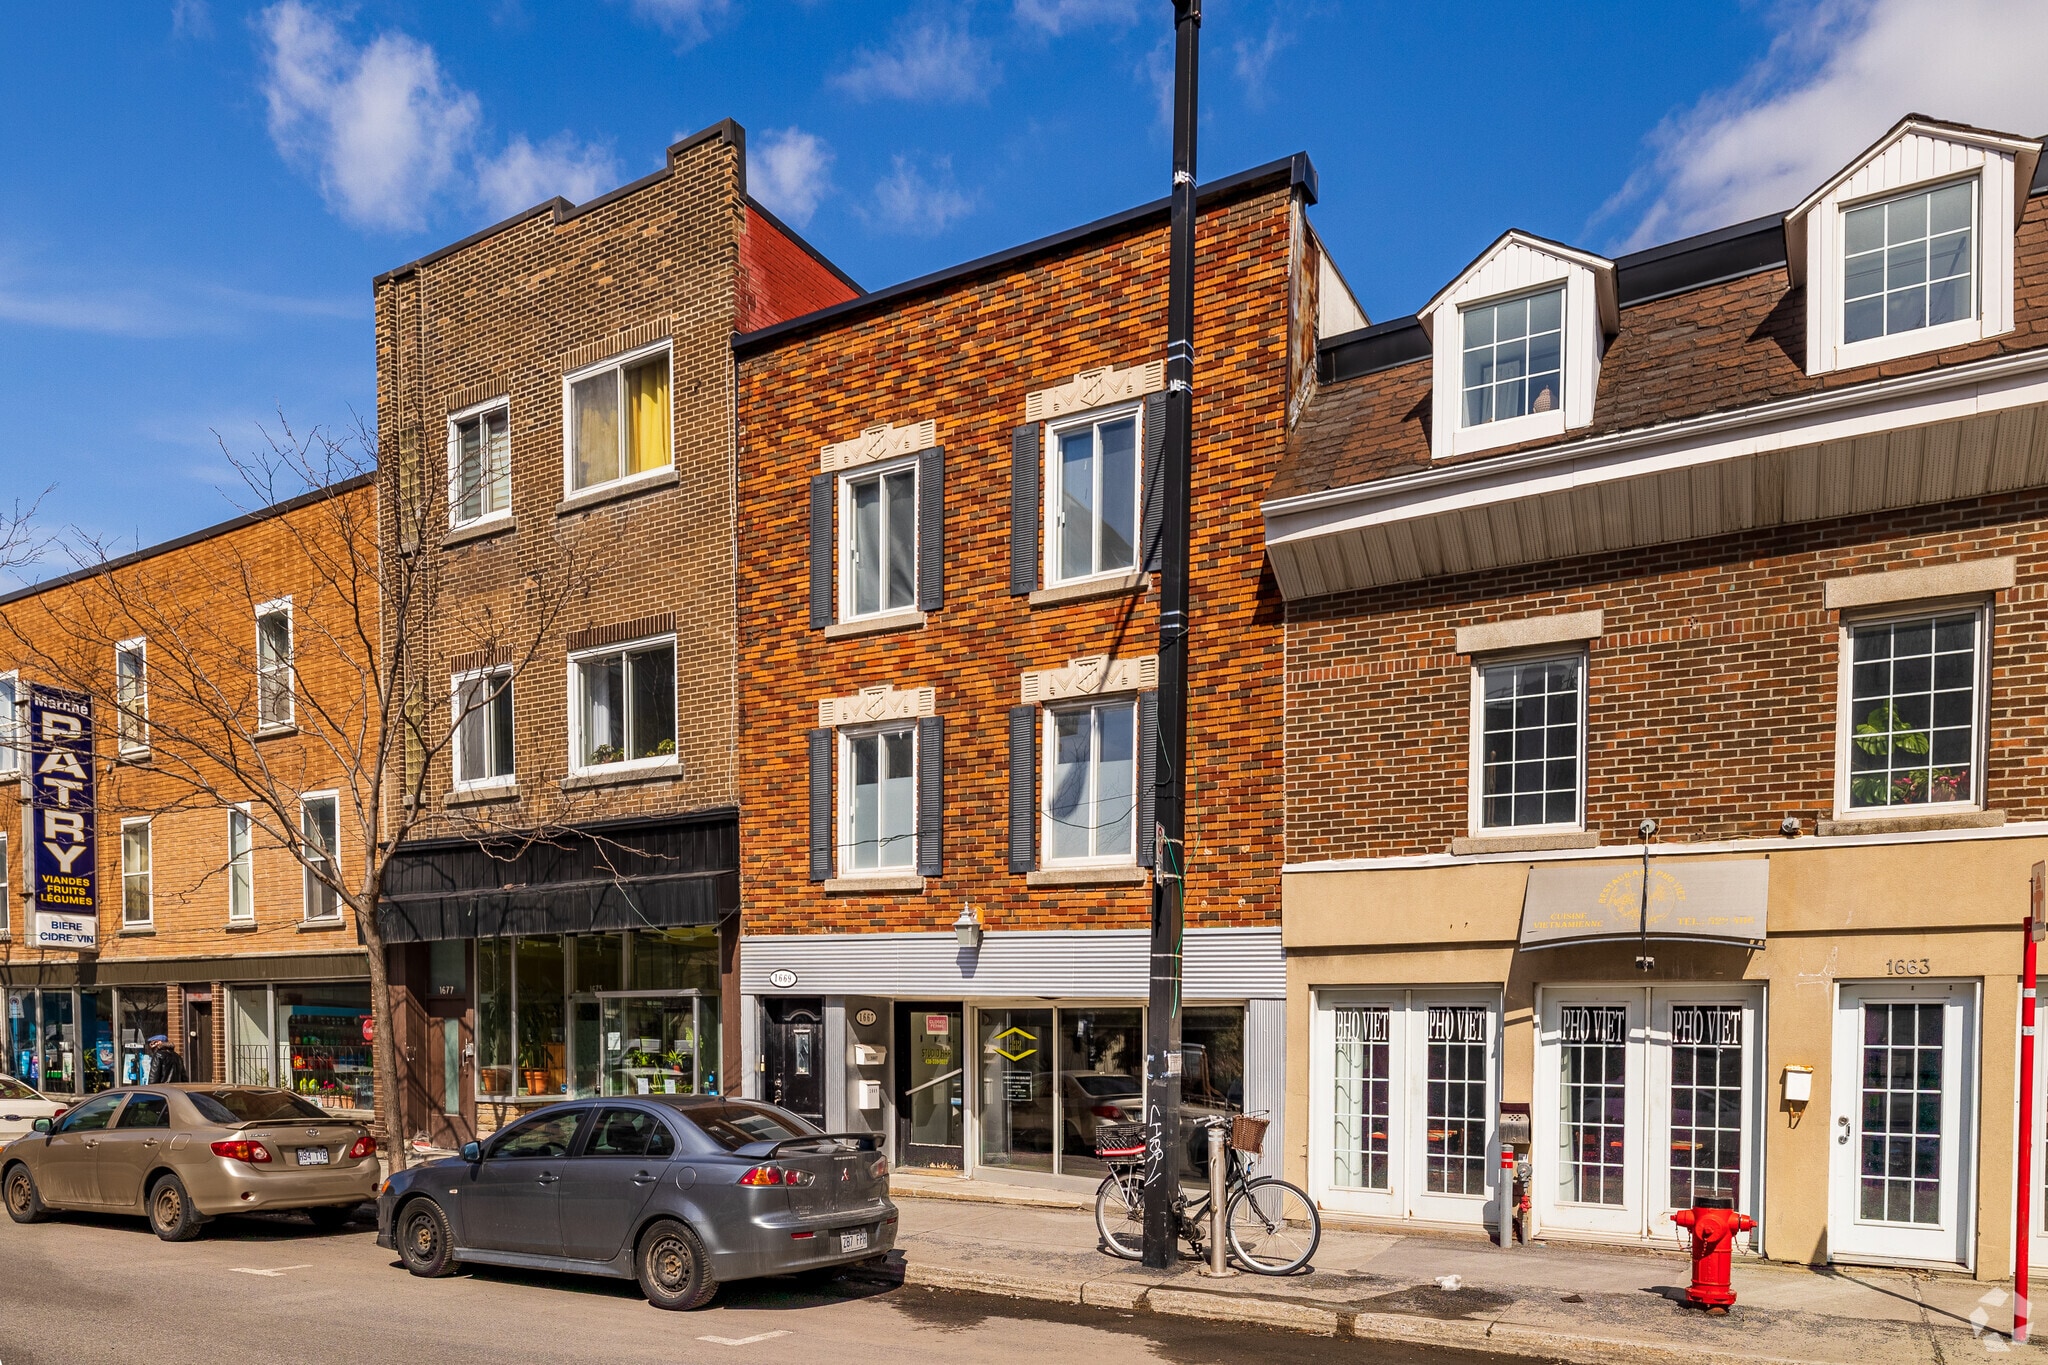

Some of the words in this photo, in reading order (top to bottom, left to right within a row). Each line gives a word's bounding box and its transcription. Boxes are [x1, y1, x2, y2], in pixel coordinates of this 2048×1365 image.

[38, 711, 88, 874] PATRY
[41, 874, 90, 887] VIANDES
[46, 884, 86, 896] FRUITS
[40, 893, 93, 906] LÉGUMES
[1550, 912, 1588, 920] CUISINE
[51, 921, 83, 931] BIERE
[1533, 920, 1604, 929] VIETNAMIENNE
[1886, 958, 1931, 975] 1663
[774, 973, 792, 983] 1669
[439, 985, 454, 995] 1677
[858, 1012, 875, 1023] 1667
[1362, 1011, 1389, 1041] VIET
[1428, 1009, 1455, 1040] PHO
[1456, 1010, 1486, 1041] VIET
[1562, 1009, 1591, 1041] PHO
[1592, 1009, 1625, 1043] VIET
[1673, 1010, 1704, 1044] PHO
[1706, 1010, 1741, 1045] VIET
